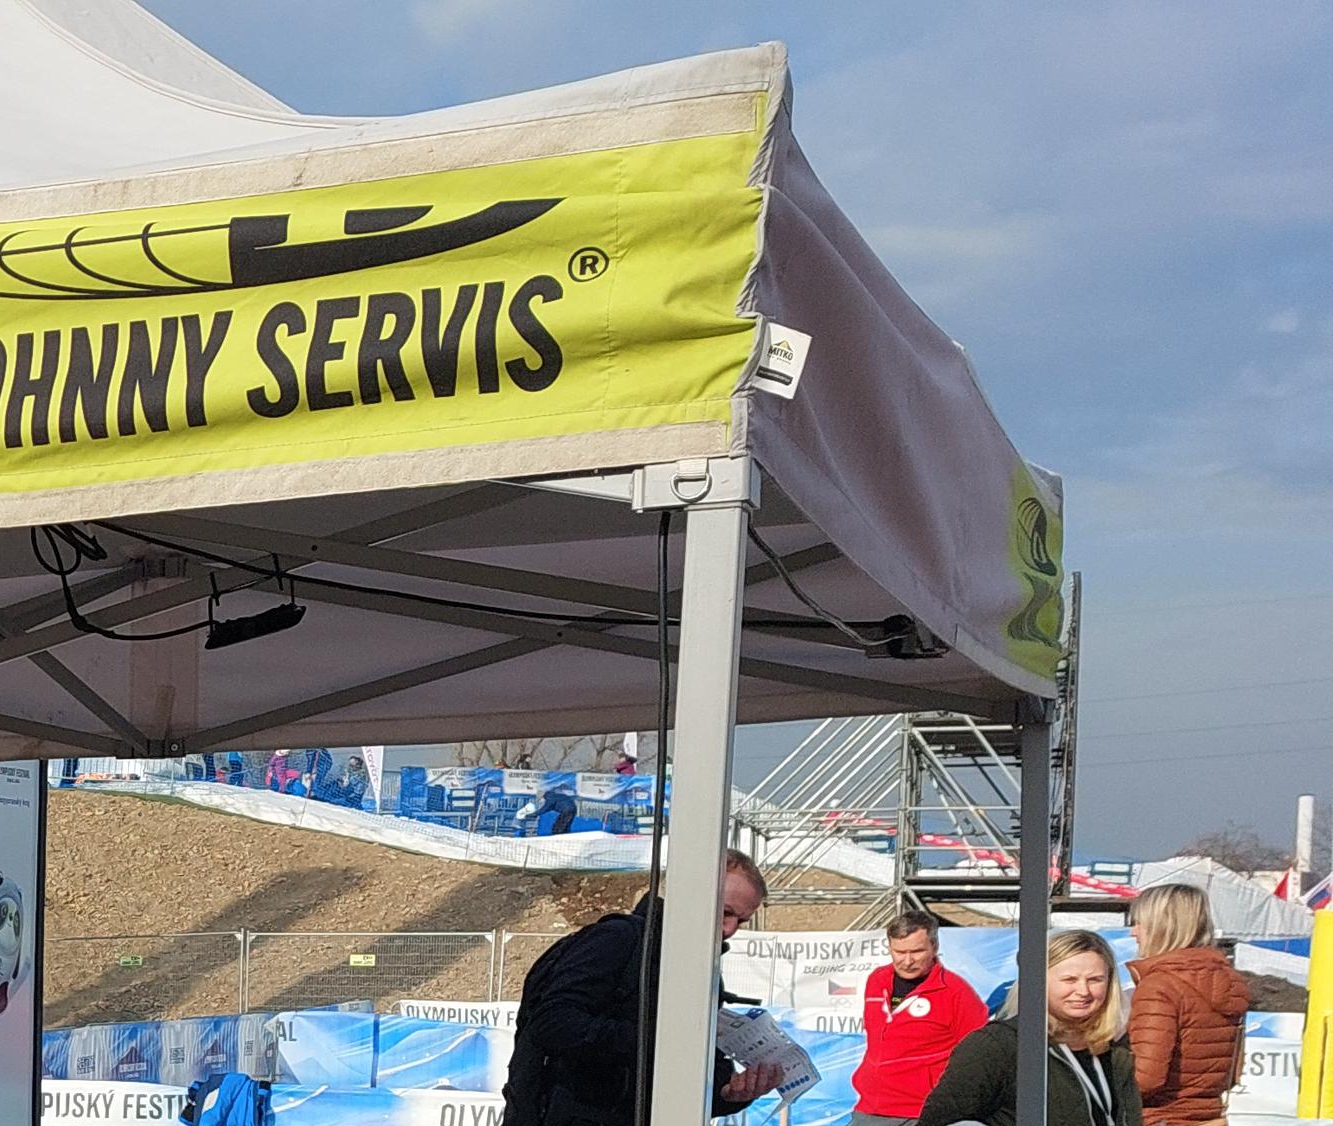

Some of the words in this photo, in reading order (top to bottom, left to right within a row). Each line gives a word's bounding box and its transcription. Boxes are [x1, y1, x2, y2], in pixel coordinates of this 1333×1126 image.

[245, 274, 564, 419] SERVIS
[746, 938, 855, 961] OLYMPIJSKÝ
[803, 962, 845, 977] BEIJING
[41, 1090, 115, 1120] PIJSKÝ
